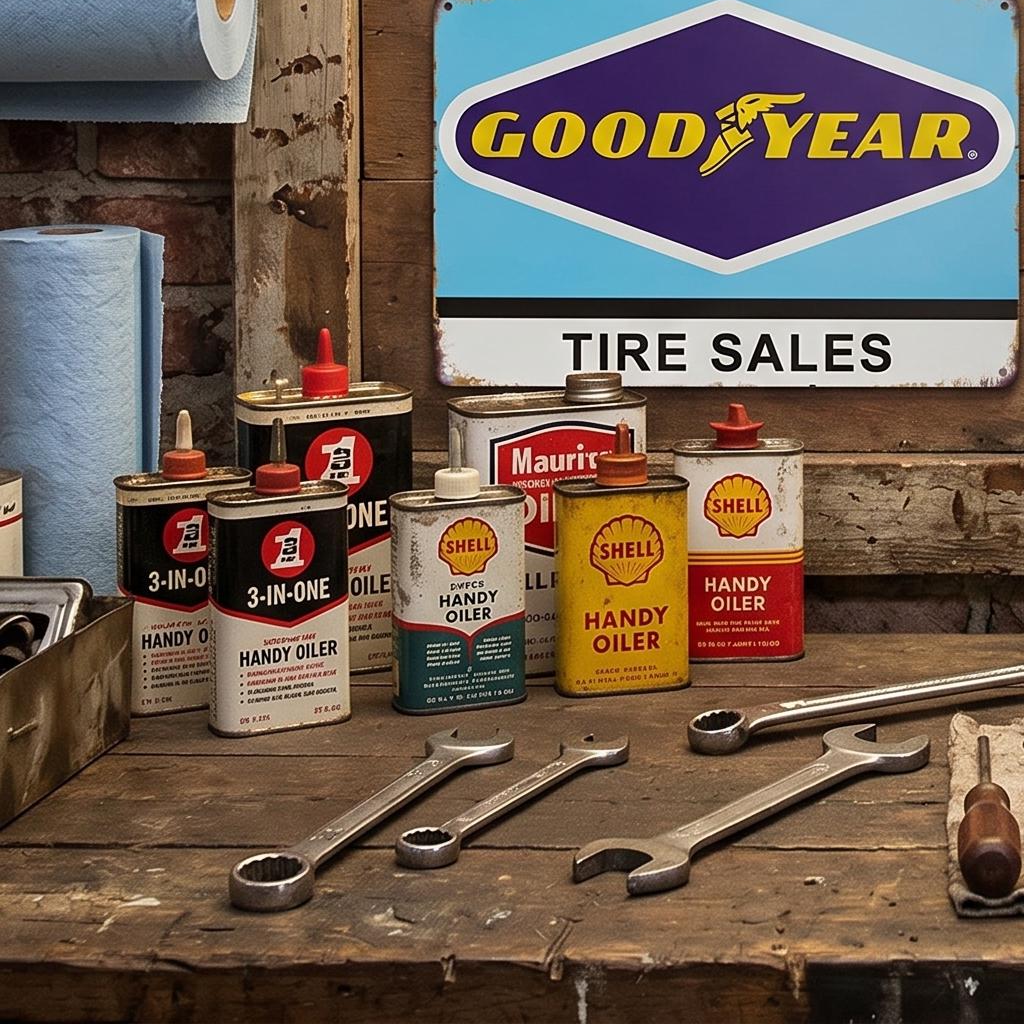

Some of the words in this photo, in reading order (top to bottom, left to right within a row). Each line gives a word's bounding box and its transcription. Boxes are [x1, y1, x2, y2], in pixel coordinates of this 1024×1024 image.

[562, 332, 688, 372] TIRE
[710, 332, 893, 373] SALES
[712, 497, 764, 514] SHELL
[446, 536, 491, 555] SHELL
[599, 539, 655, 561] SHELL
[148, 566, 207, 593] 3-IN-O
[350, 573, 391, 597] OILE
[704, 575, 772, 593] HANDY
[247, 576, 331, 609] 3-IN-ONE
[439, 589, 498, 608] HANDY
[710, 595, 766, 612] OILER
[445, 606, 492, 624] OILER
[584, 605, 669, 631] HANDY
[141, 628, 194, 651] HANDY
[592, 630, 661, 654] OILER
[239, 645, 292, 668] HANDY
[295, 639, 338, 660] OILER
